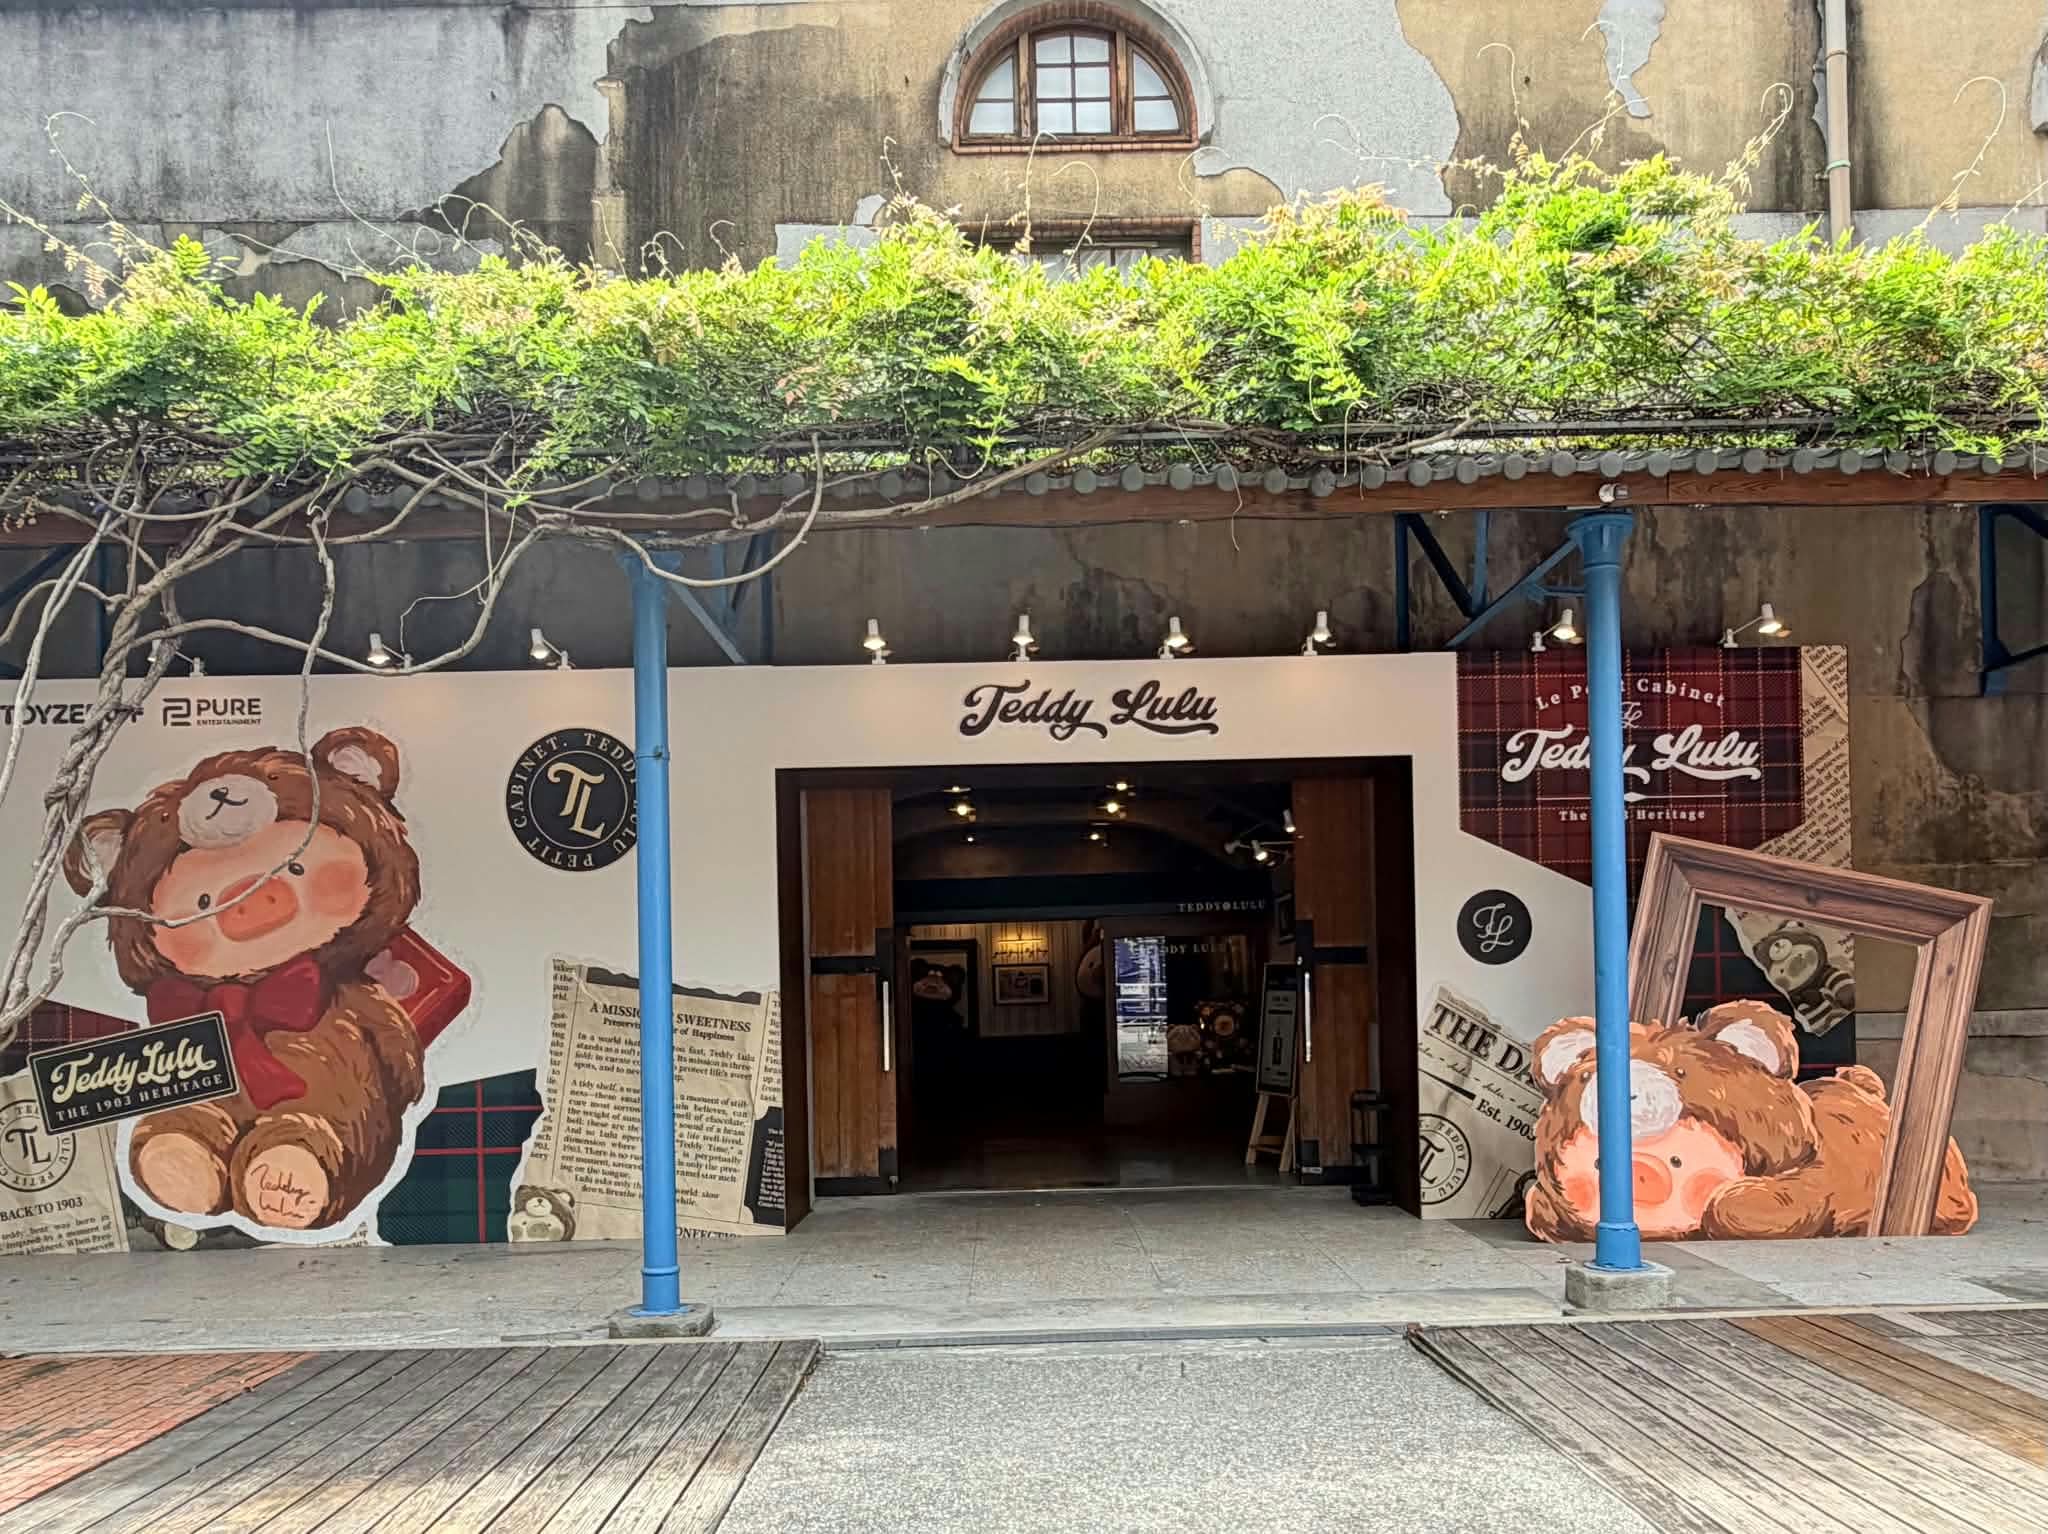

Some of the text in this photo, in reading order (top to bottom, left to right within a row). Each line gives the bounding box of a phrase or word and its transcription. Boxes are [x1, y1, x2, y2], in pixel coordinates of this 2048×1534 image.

[196, 698, 262, 716] PURE
[960, 679, 1219, 741] Teddy Lulu
[1536, 694, 1561, 711] Le
[1637, 678, 1725, 708] Cabinet
[196, 718, 262, 726] ENTERTAINMENT
[1502, 723, 1762, 785] Tedy Lulu
[1559, 810, 1588, 821] The
[1636, 809, 1705, 821] Heritage
[590, 1001, 599, 1013] A
[676, 1013, 752, 1032] SWEETNESS
[1429, 1002, 1498, 1062] THE
[50, 1037, 217, 1104] Teddy Lulu
[55, 1073, 224, 1122] THE 1903 HERITAGE
[1476, 1098, 1502, 1123] Est.
[0, 1196, 83, 1222] BACK TO 1903
